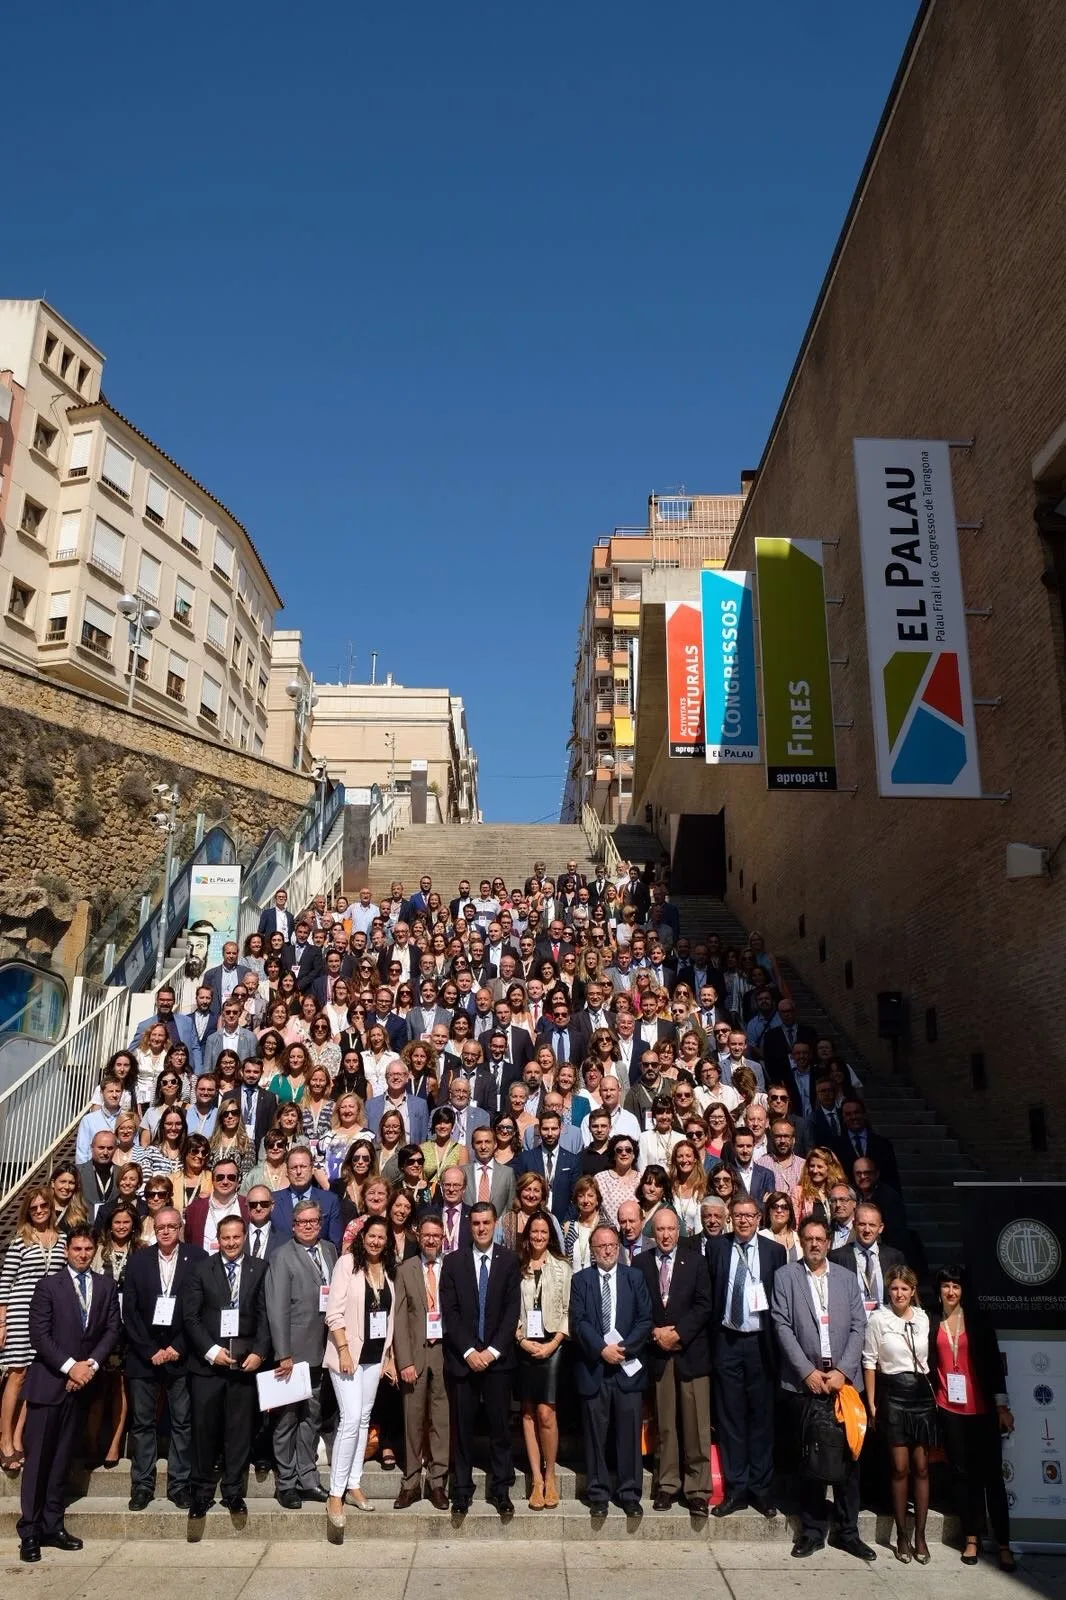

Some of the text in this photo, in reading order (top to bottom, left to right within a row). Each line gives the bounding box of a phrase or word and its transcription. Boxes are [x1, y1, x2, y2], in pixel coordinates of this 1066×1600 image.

[921, 451, 933, 497] Tarragona
[924, 500, 933, 511] de
[885, 467, 929, 641] EL PALAU
[926, 512, 939, 568] Congressos
[930, 571, 940, 583] de
[931, 591, 943, 611] Firal
[935, 614, 946, 642] Palau
[721, 600, 742, 738] CONGRESSOS
[685, 645, 701, 738] CULTURALS
[680, 698, 688, 737] ACTIVITATS
[787, 680, 814, 756] FIRES
[675, 746, 706, 755] apropa't
[713, 749, 754, 758] EL PALAU
[776, 772, 828, 785] apropa't!
